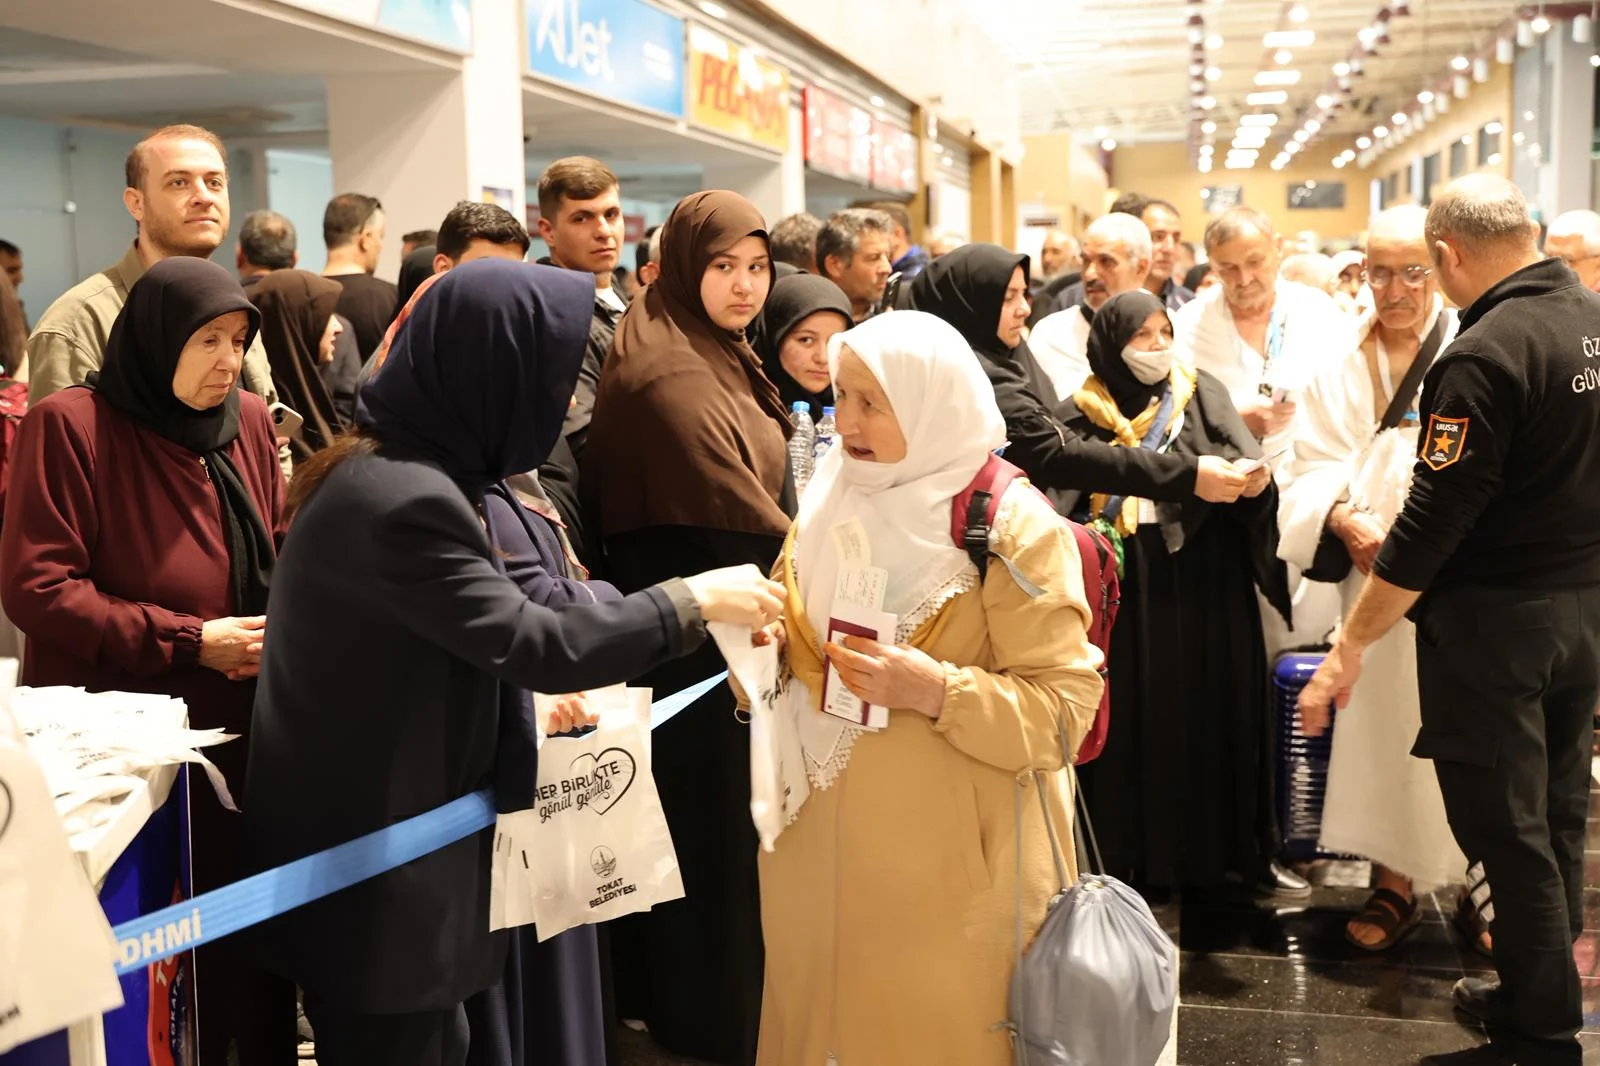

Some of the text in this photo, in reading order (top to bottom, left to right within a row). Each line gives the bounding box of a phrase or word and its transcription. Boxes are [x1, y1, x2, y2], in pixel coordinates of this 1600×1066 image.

[561, 761, 620, 793] BİRLKTE
[589, 884, 637, 908] BELEDİYESİ
[597, 878, 623, 894] TOKAT
[119, 908, 202, 968] DHMİ
